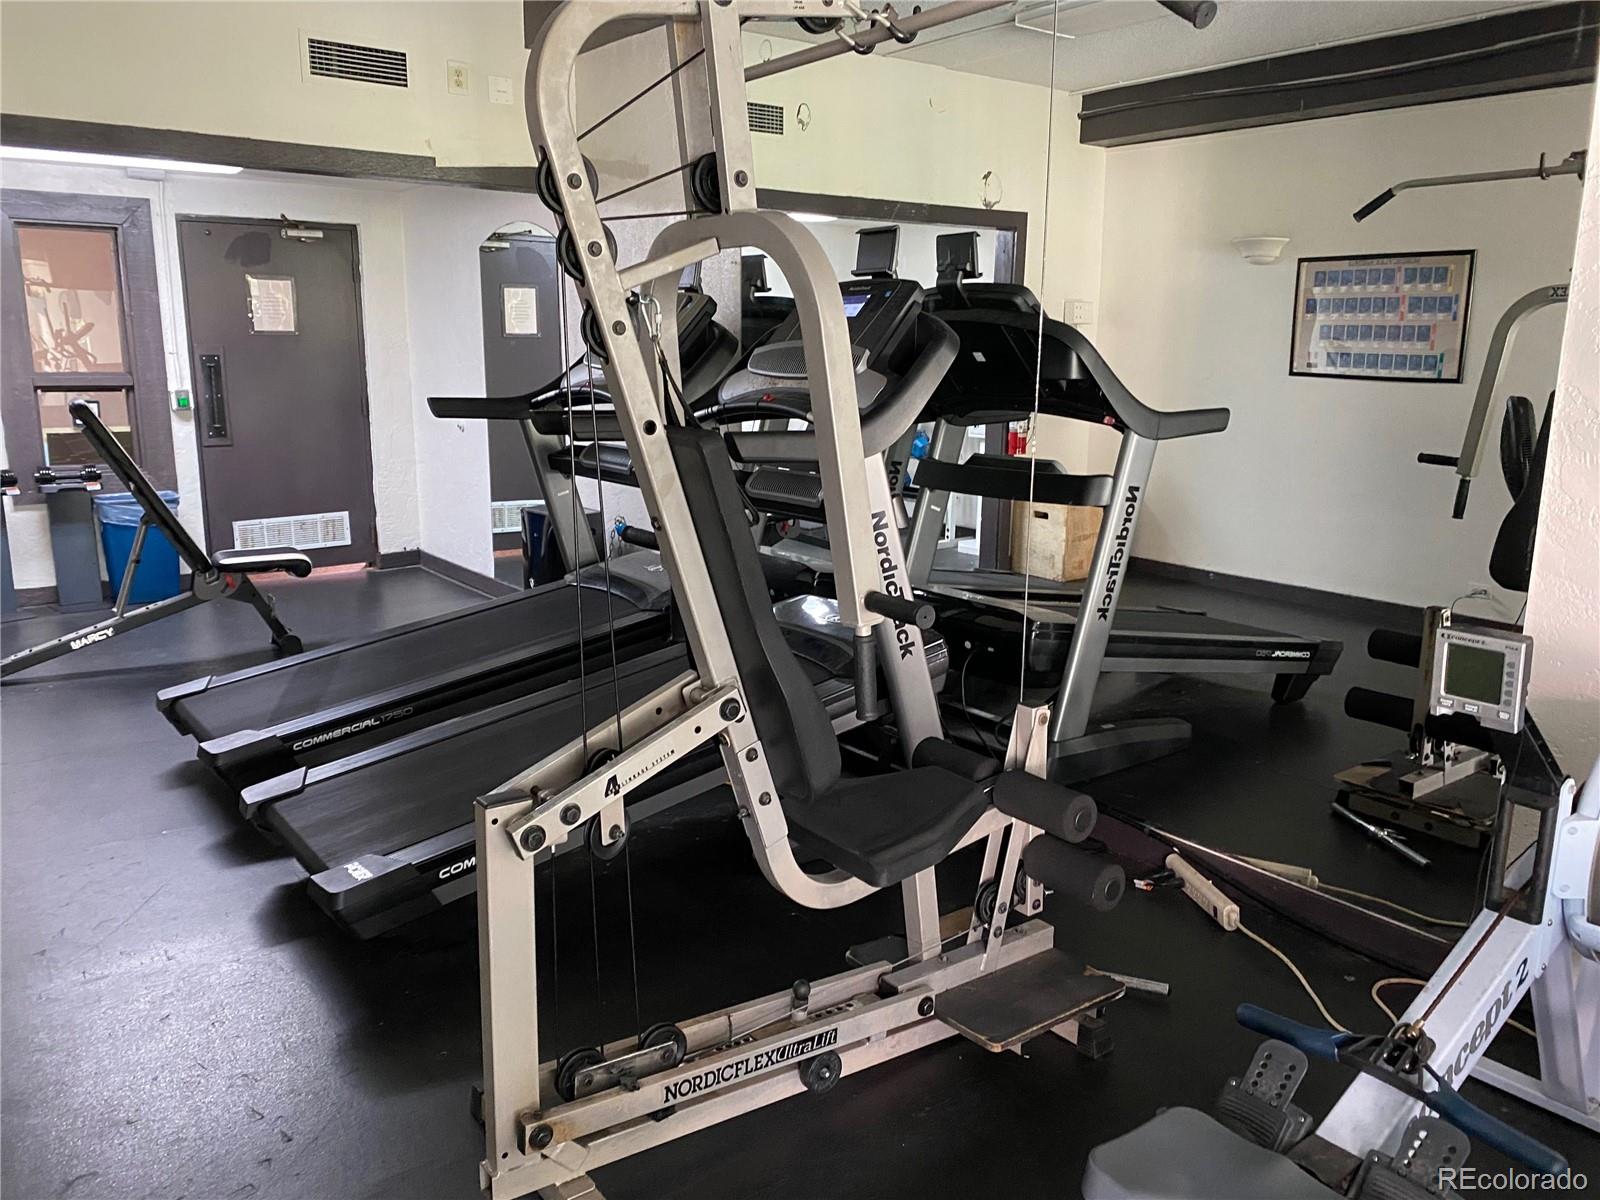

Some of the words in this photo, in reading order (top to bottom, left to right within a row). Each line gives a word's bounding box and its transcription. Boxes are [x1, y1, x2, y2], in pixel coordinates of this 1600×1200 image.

[871, 510, 915, 660] Nordicack
[70, 627, 114, 649] MARCY
[293, 718, 380, 751] COMMERCIAL
[380, 706, 414, 722] 1750
[604, 774, 621, 798] 4
[1516, 957, 1529, 992] 2
[664, 1049, 778, 1103] NORDICFLEX
